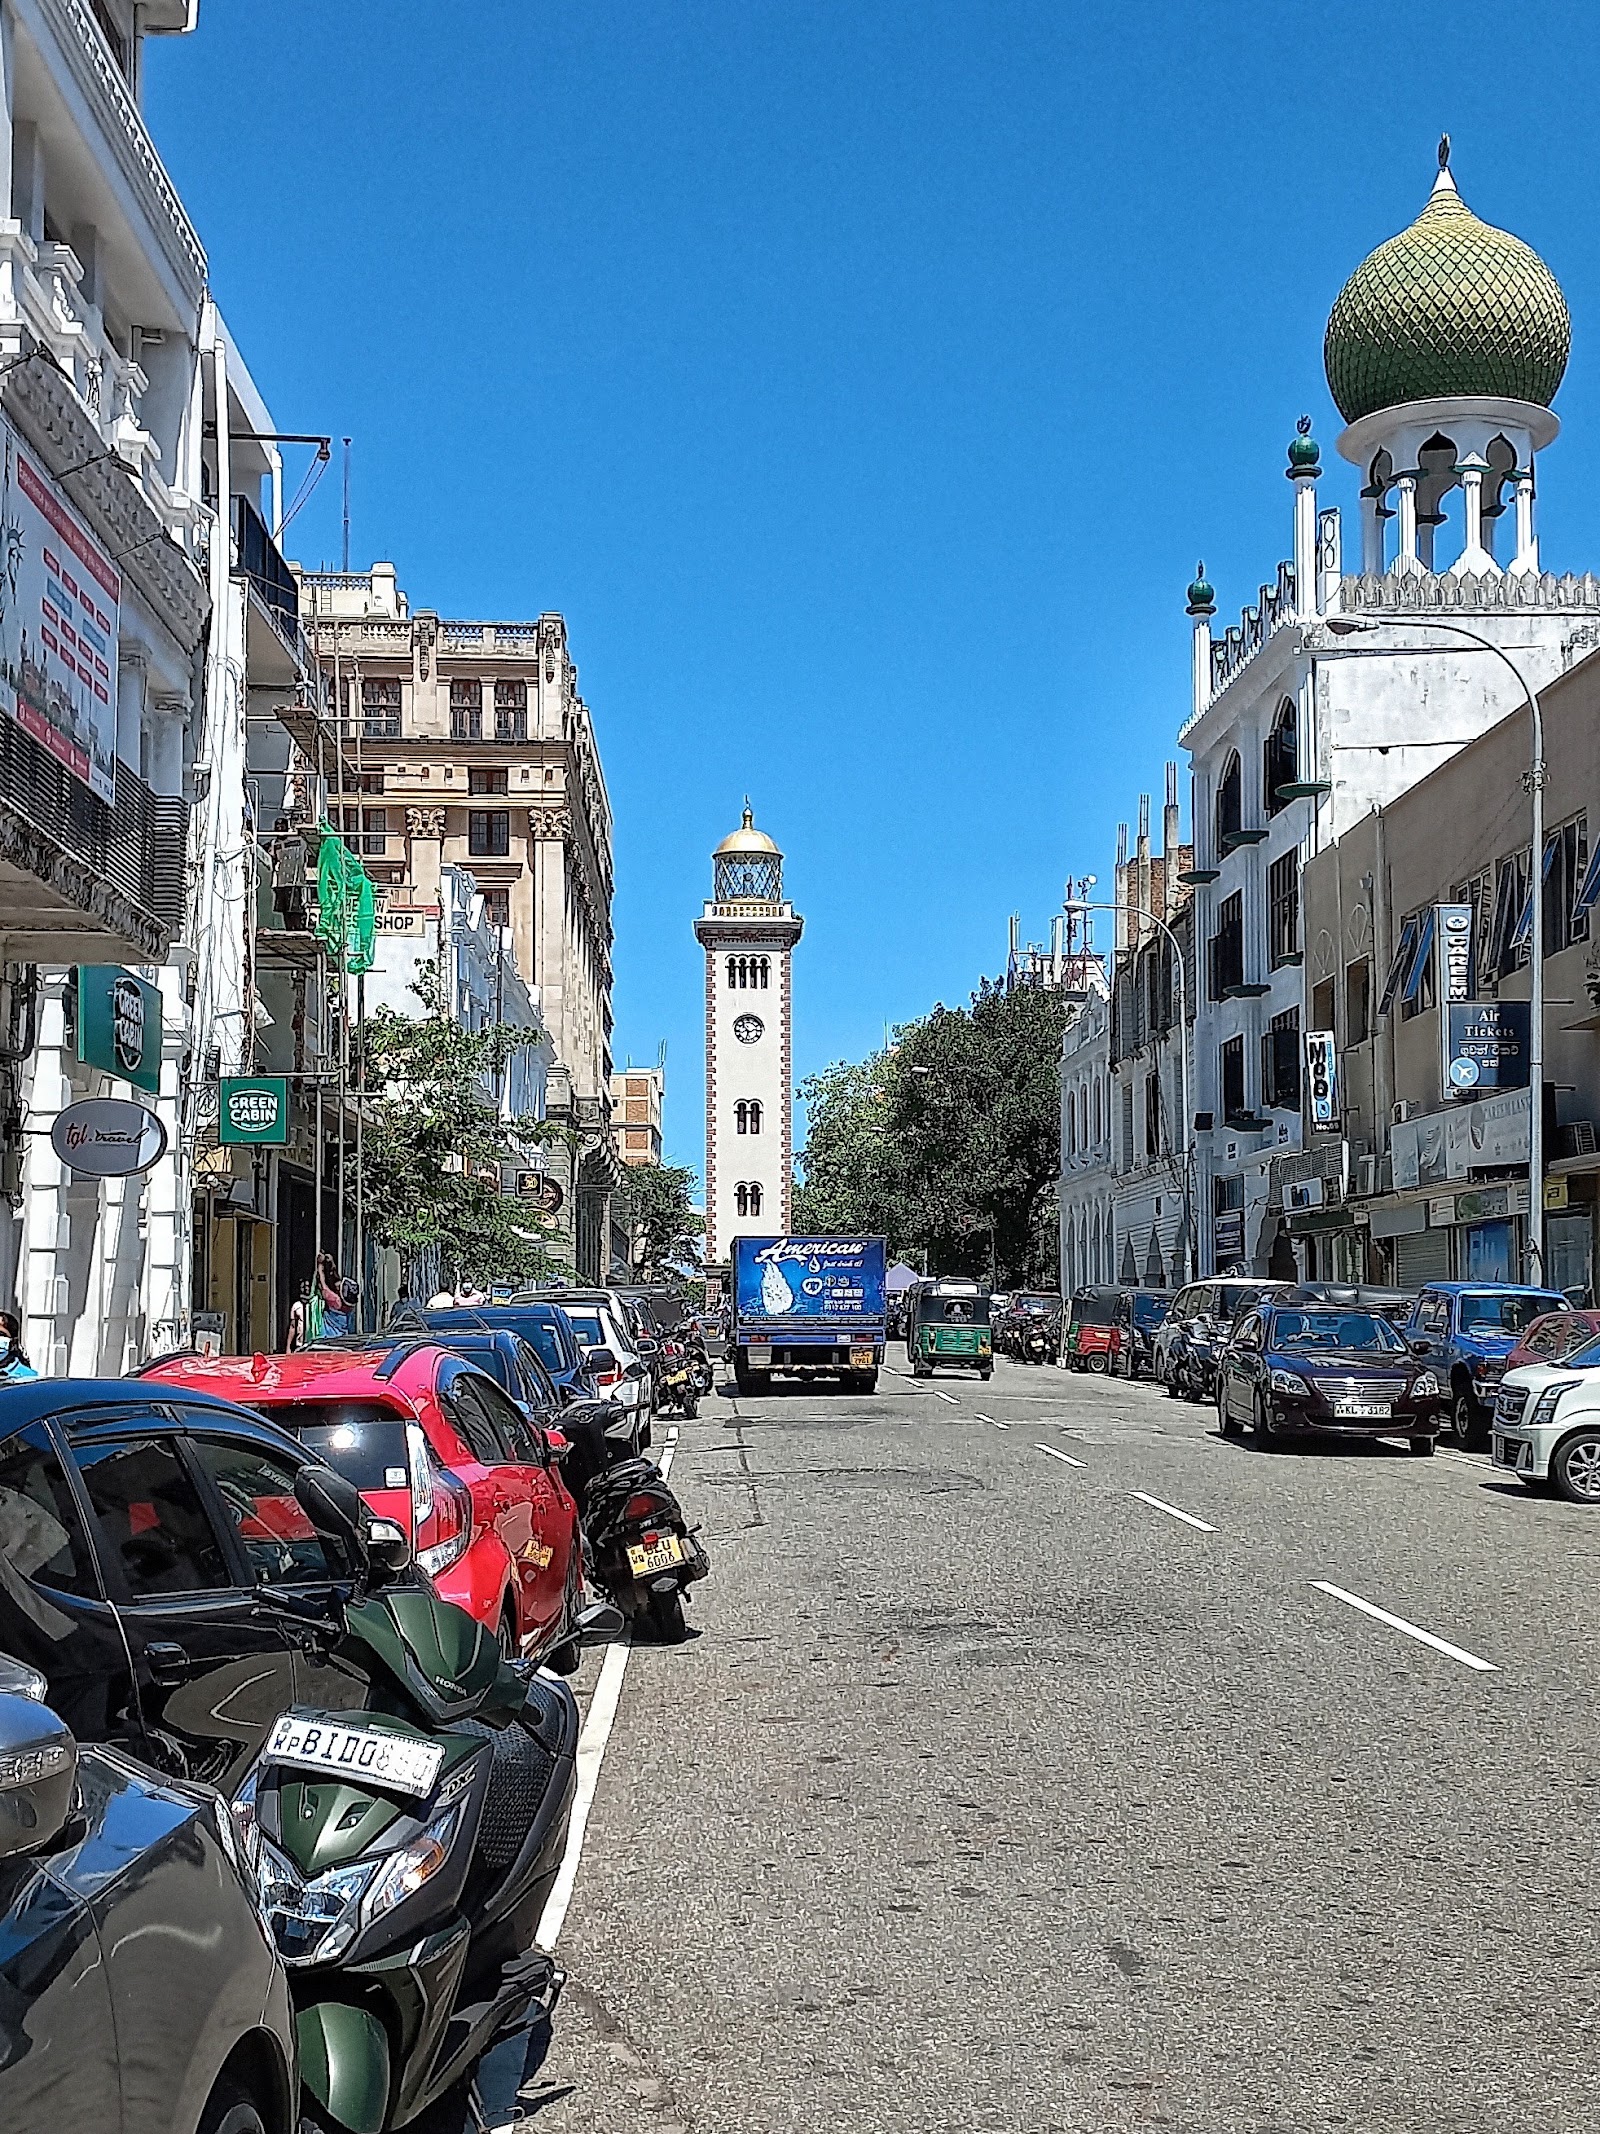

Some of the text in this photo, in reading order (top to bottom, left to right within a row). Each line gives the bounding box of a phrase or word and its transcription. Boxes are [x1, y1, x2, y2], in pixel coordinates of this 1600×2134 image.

[373, 915, 414, 930] SHOP
[1448, 935, 1469, 1000] CAREEM
[1479, 1010, 1500, 1022] Air
[1465, 1026, 1514, 1037] Tickets
[228, 1097, 278, 1110] GREEN
[230, 1109, 277, 1121] CABIN
[755, 1238, 864, 1264] American
[435, 1675, 468, 1697] HONDA
